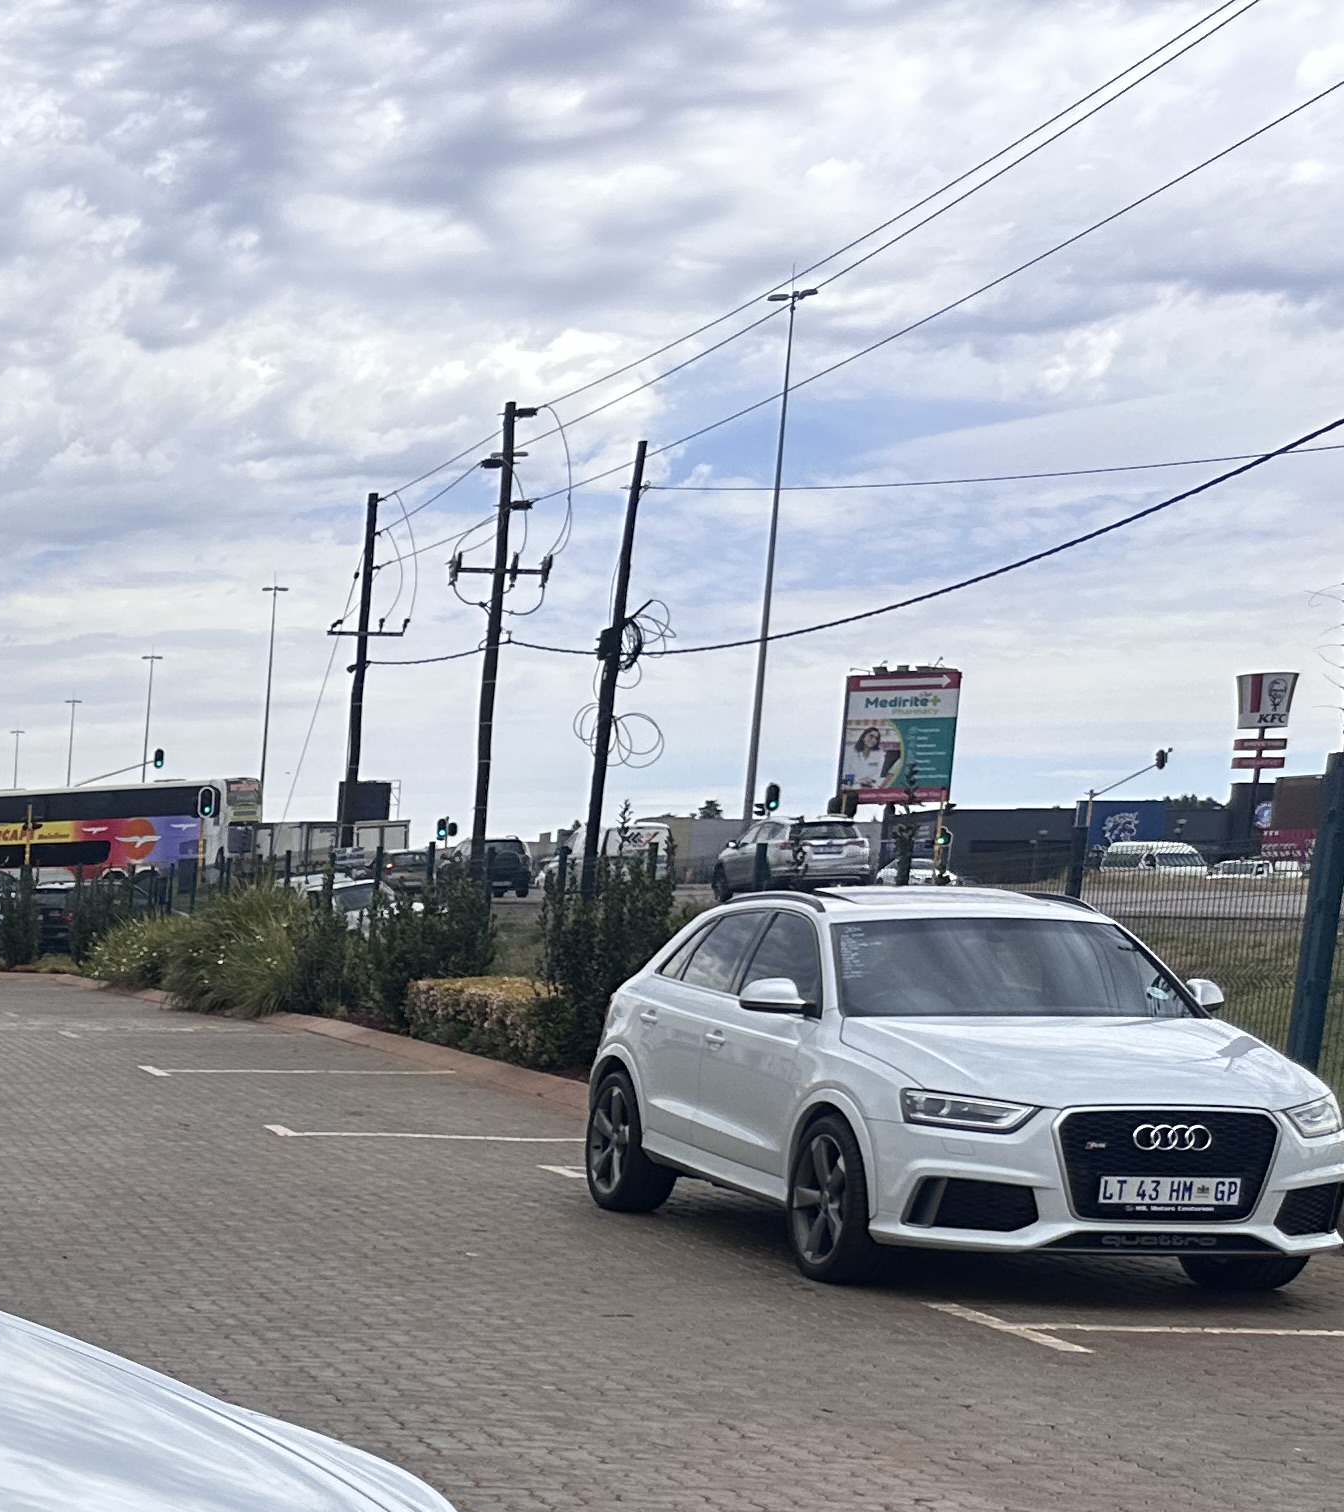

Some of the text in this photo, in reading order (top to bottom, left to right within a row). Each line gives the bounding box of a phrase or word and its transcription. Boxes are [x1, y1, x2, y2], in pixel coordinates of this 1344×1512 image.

[1257, 713, 1287, 724] KFC
[1102, 1179, 1238, 1202] LT 43 HM GP
[1101, 1235, 1217, 1247] quattro
